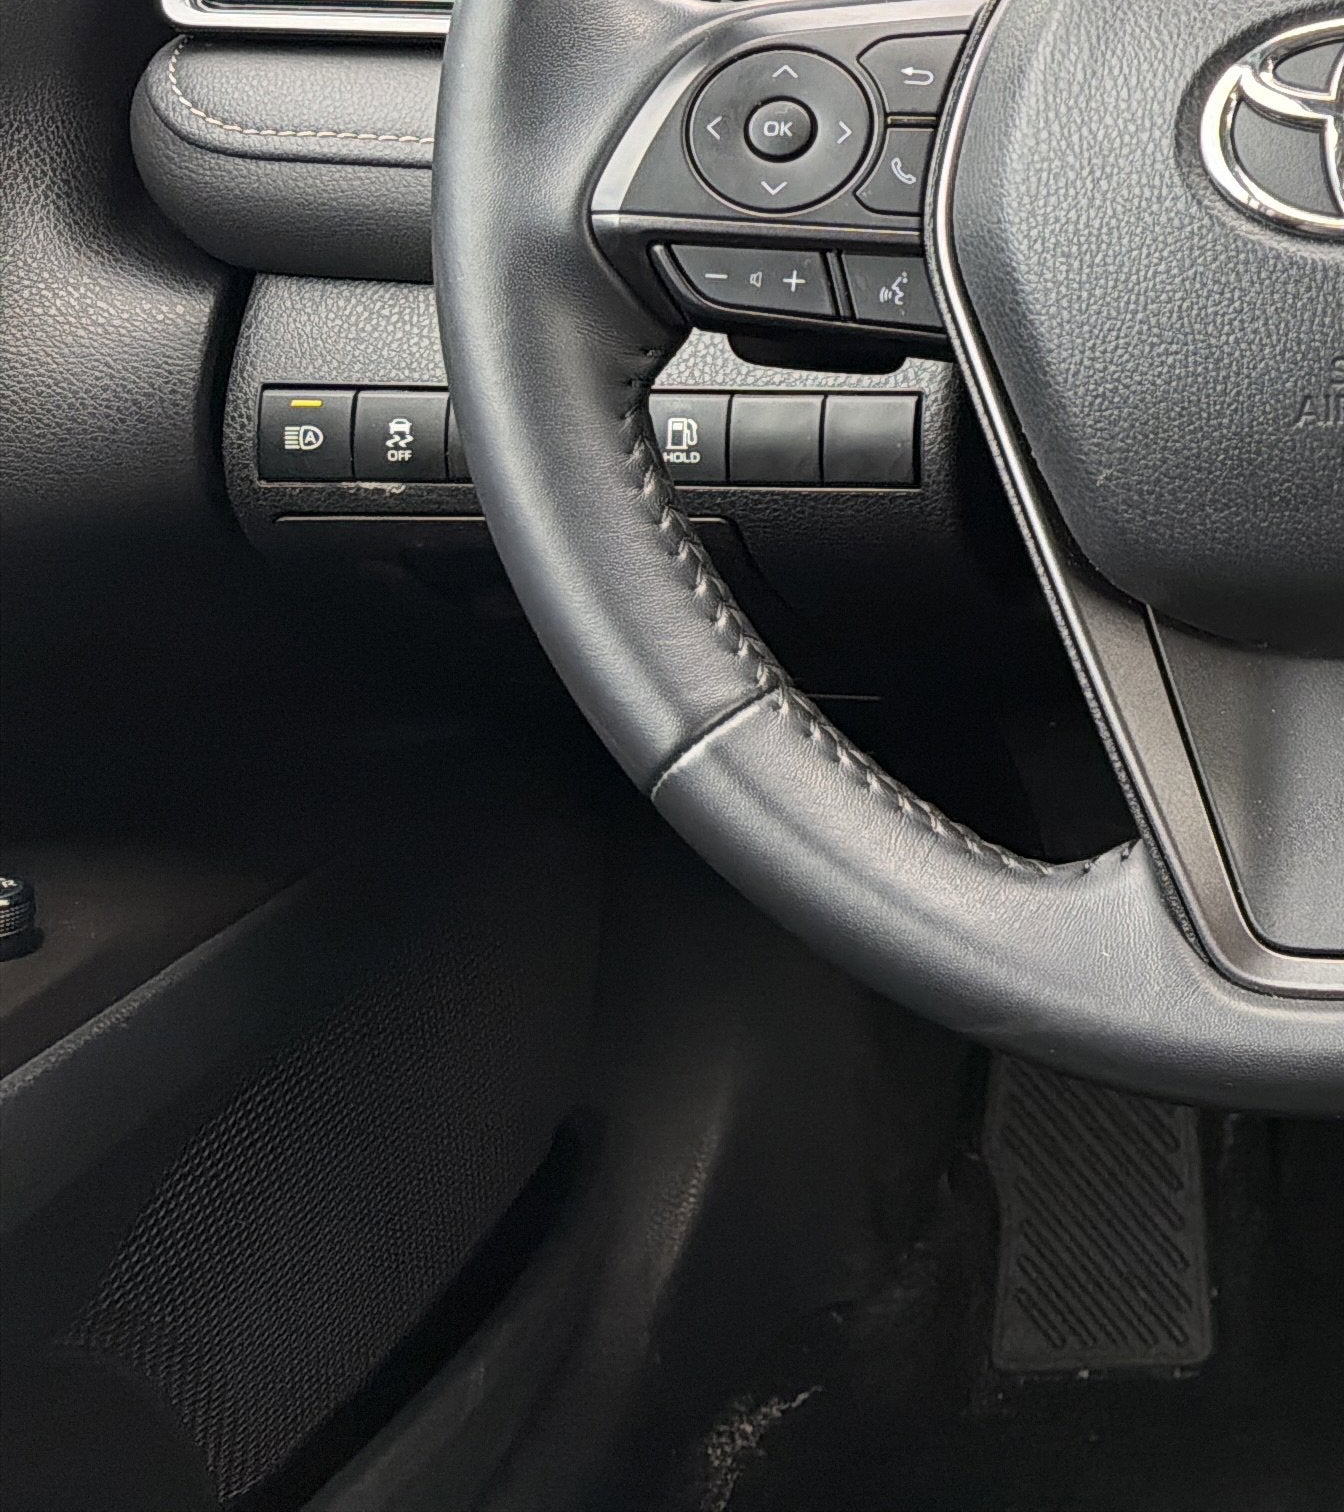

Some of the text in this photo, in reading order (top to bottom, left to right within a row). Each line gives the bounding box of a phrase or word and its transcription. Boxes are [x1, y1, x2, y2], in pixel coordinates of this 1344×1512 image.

[763, 120, 793, 138] OK
[387, 450, 413, 462] OFF
[664, 451, 701, 465] HOLD
